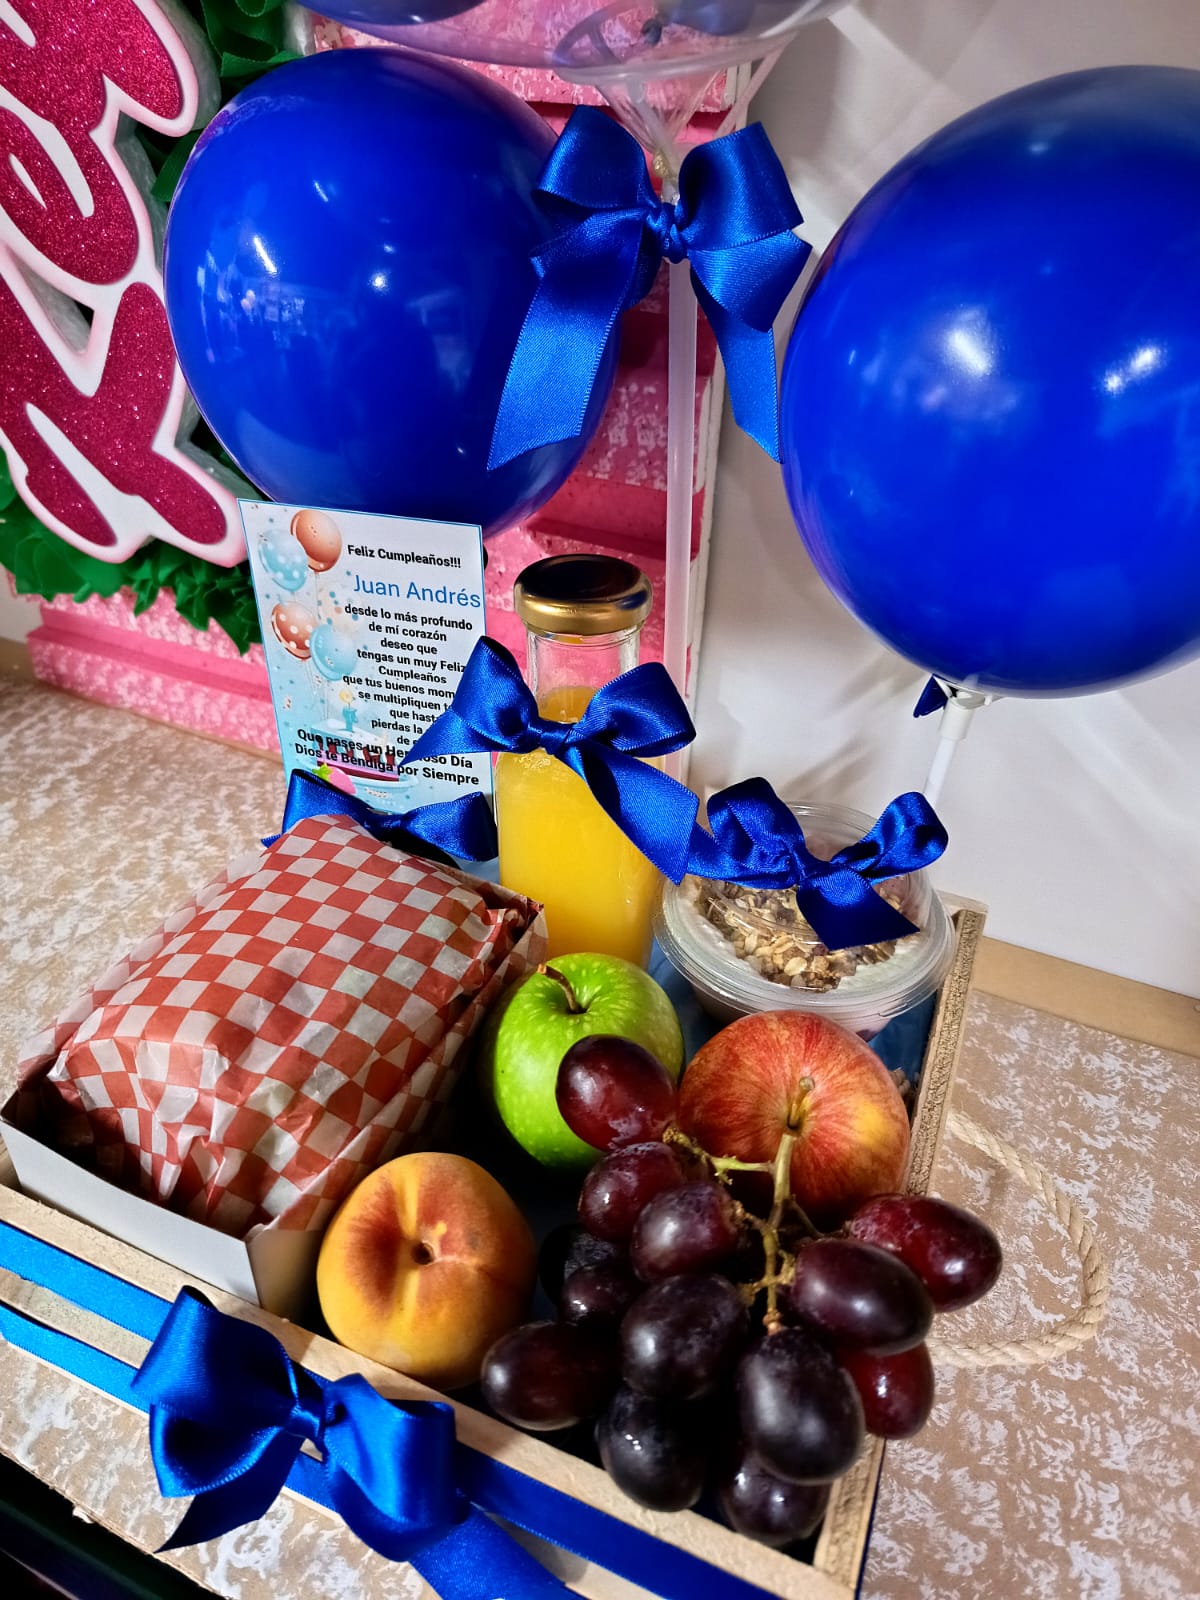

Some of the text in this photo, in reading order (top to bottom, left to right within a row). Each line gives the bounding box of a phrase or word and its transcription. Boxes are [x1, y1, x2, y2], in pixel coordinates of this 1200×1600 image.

[347, 544, 461, 569] Feliz Cumpleaños!!!
[354, 574, 481, 608] Juan Andrés
[344, 603, 473, 631] desde lo más profundo
[368, 621, 447, 641] de mí corazón
[380, 637, 438, 655] deseo que
[356, 649, 394, 663] tengas
[396, 655, 411, 665] un
[413, 658, 437, 671] muy
[378, 665, 447, 684] Cumpleaños
[342, 675, 363, 685] que
[365, 677, 382, 688] tus
[385, 680, 425, 695] buenos
[358, 691, 371, 700] se
[373, 693, 441, 711] multipliquen
[389, 709, 437, 723] que hast
[371, 718, 423, 735] pierdas la
[297, 728, 324, 745] Que
[325, 736, 364, 751] pases
[366, 743, 383, 755] un
[450, 755, 473, 769] Día
[396, 735, 410, 746] de
[294, 743, 479, 786] Dios te Bendiga por Siempre
